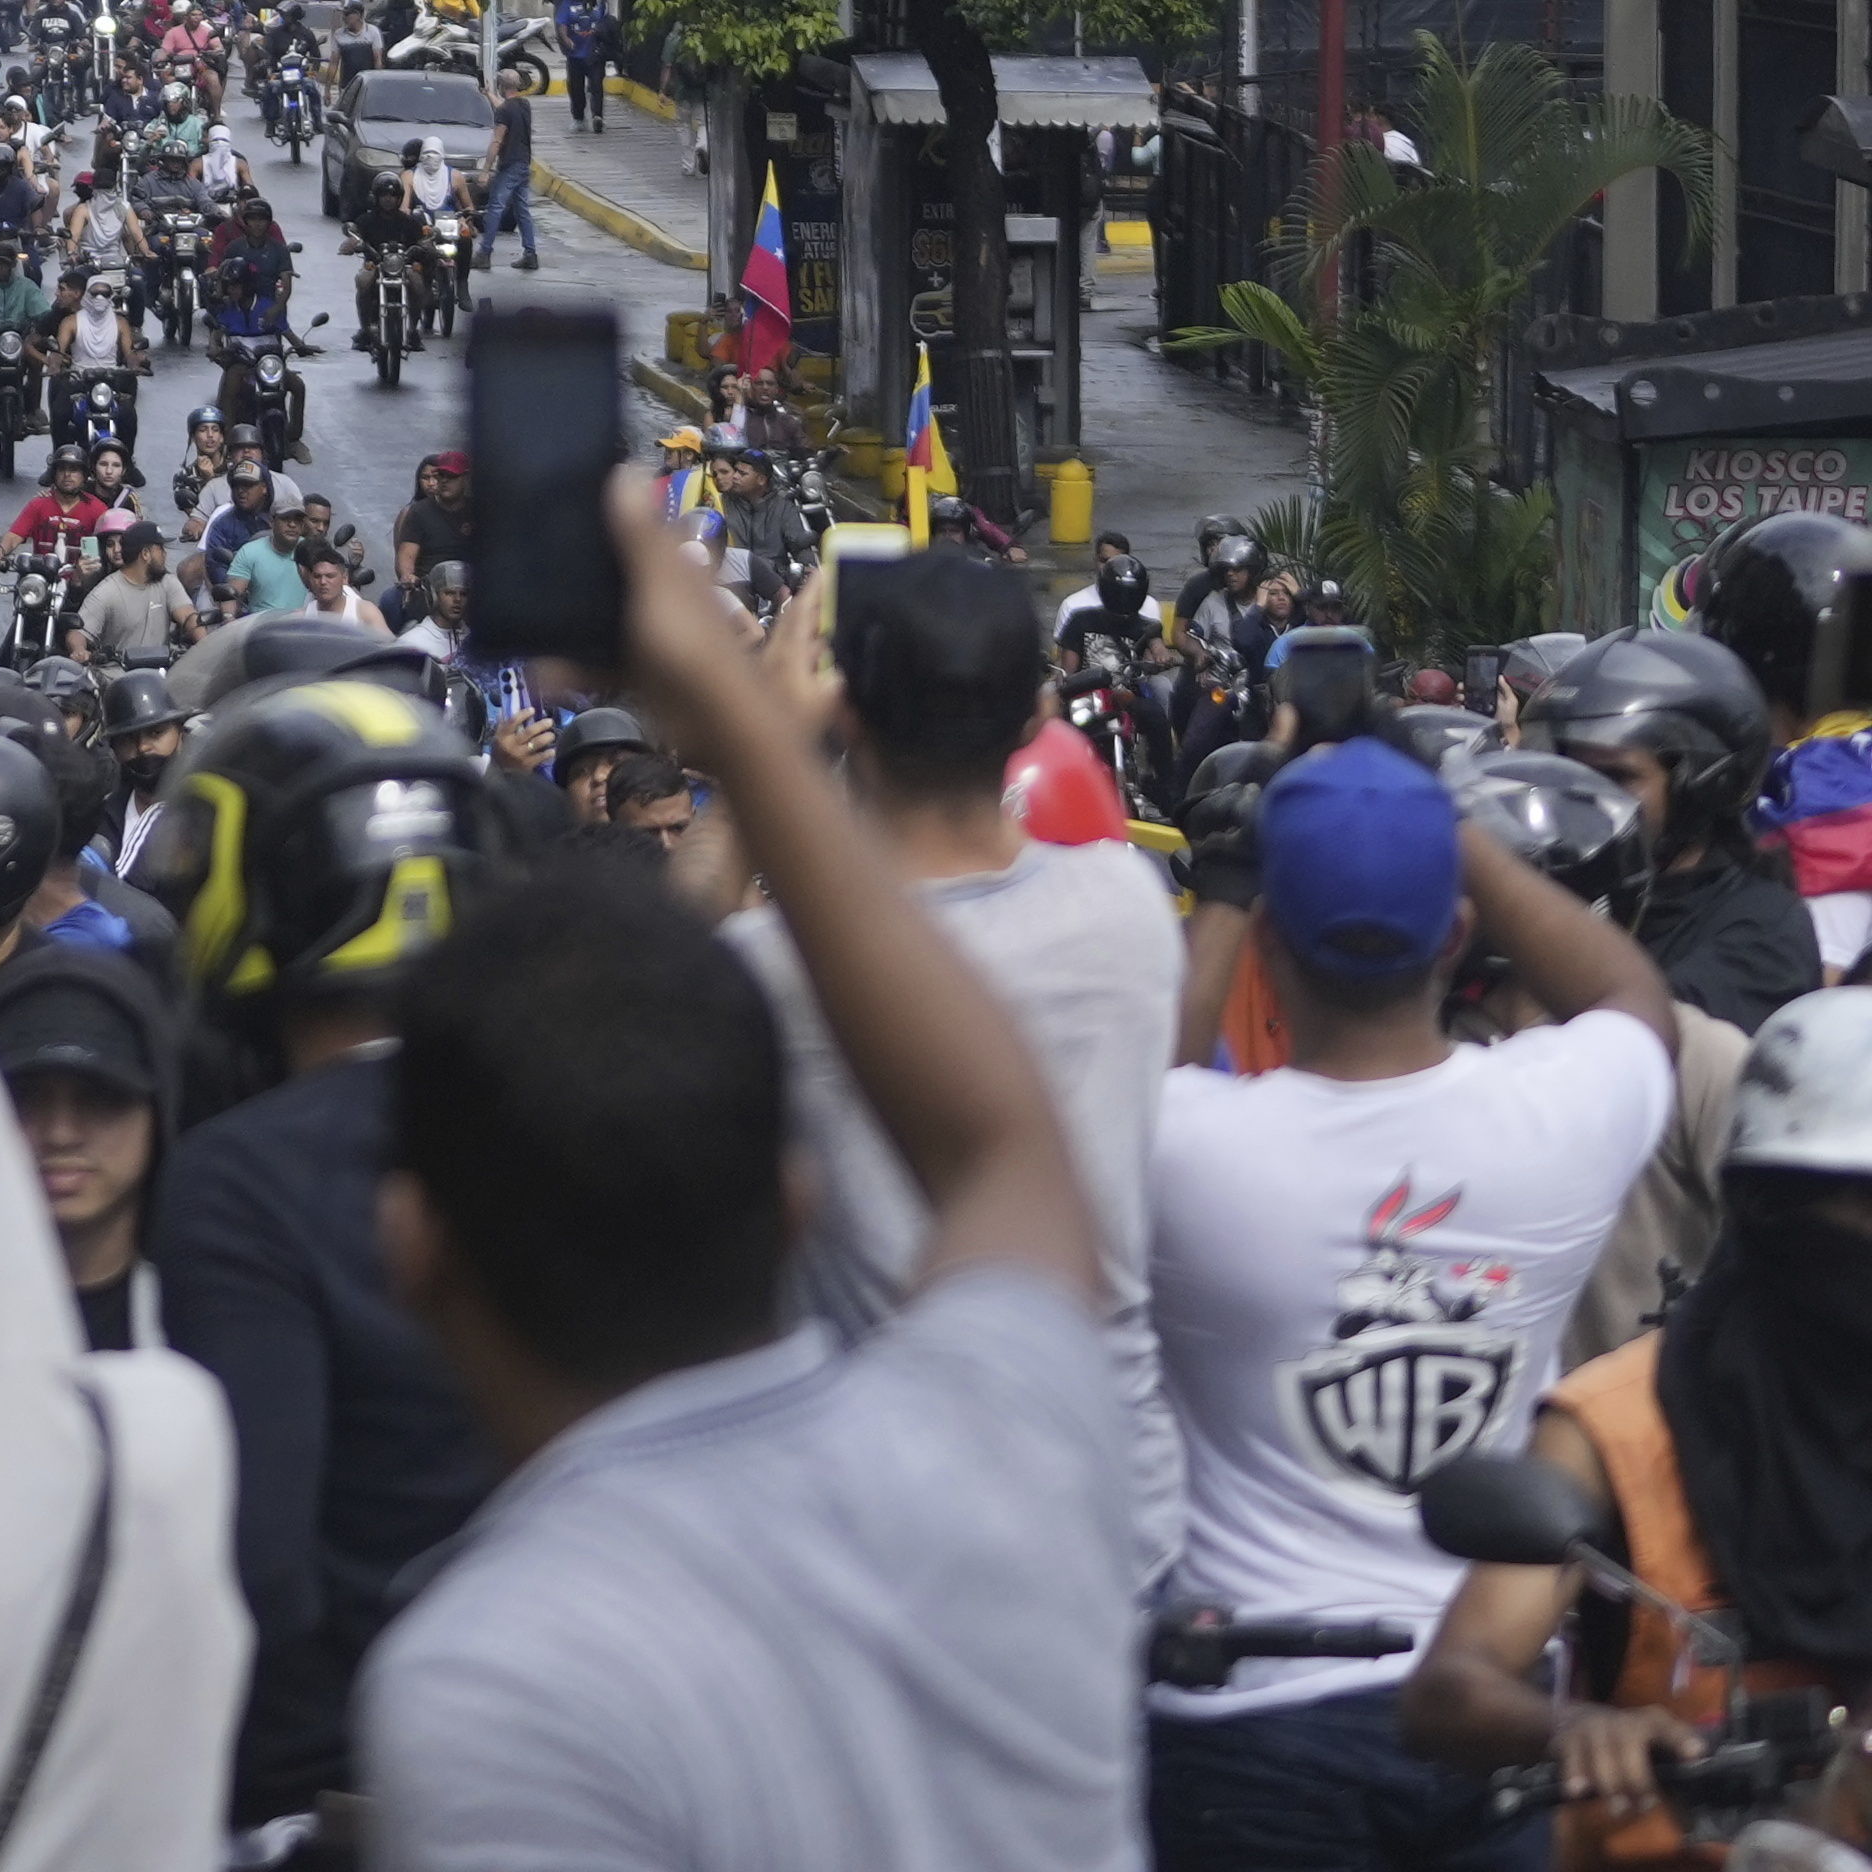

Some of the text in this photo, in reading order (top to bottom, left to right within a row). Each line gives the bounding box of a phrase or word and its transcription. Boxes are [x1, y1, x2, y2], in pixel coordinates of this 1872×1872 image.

[1686, 448, 1848, 482] KIOSCO
[1664, 484, 1745, 518] LOS
[1312, 1352, 1497, 1488] WB
